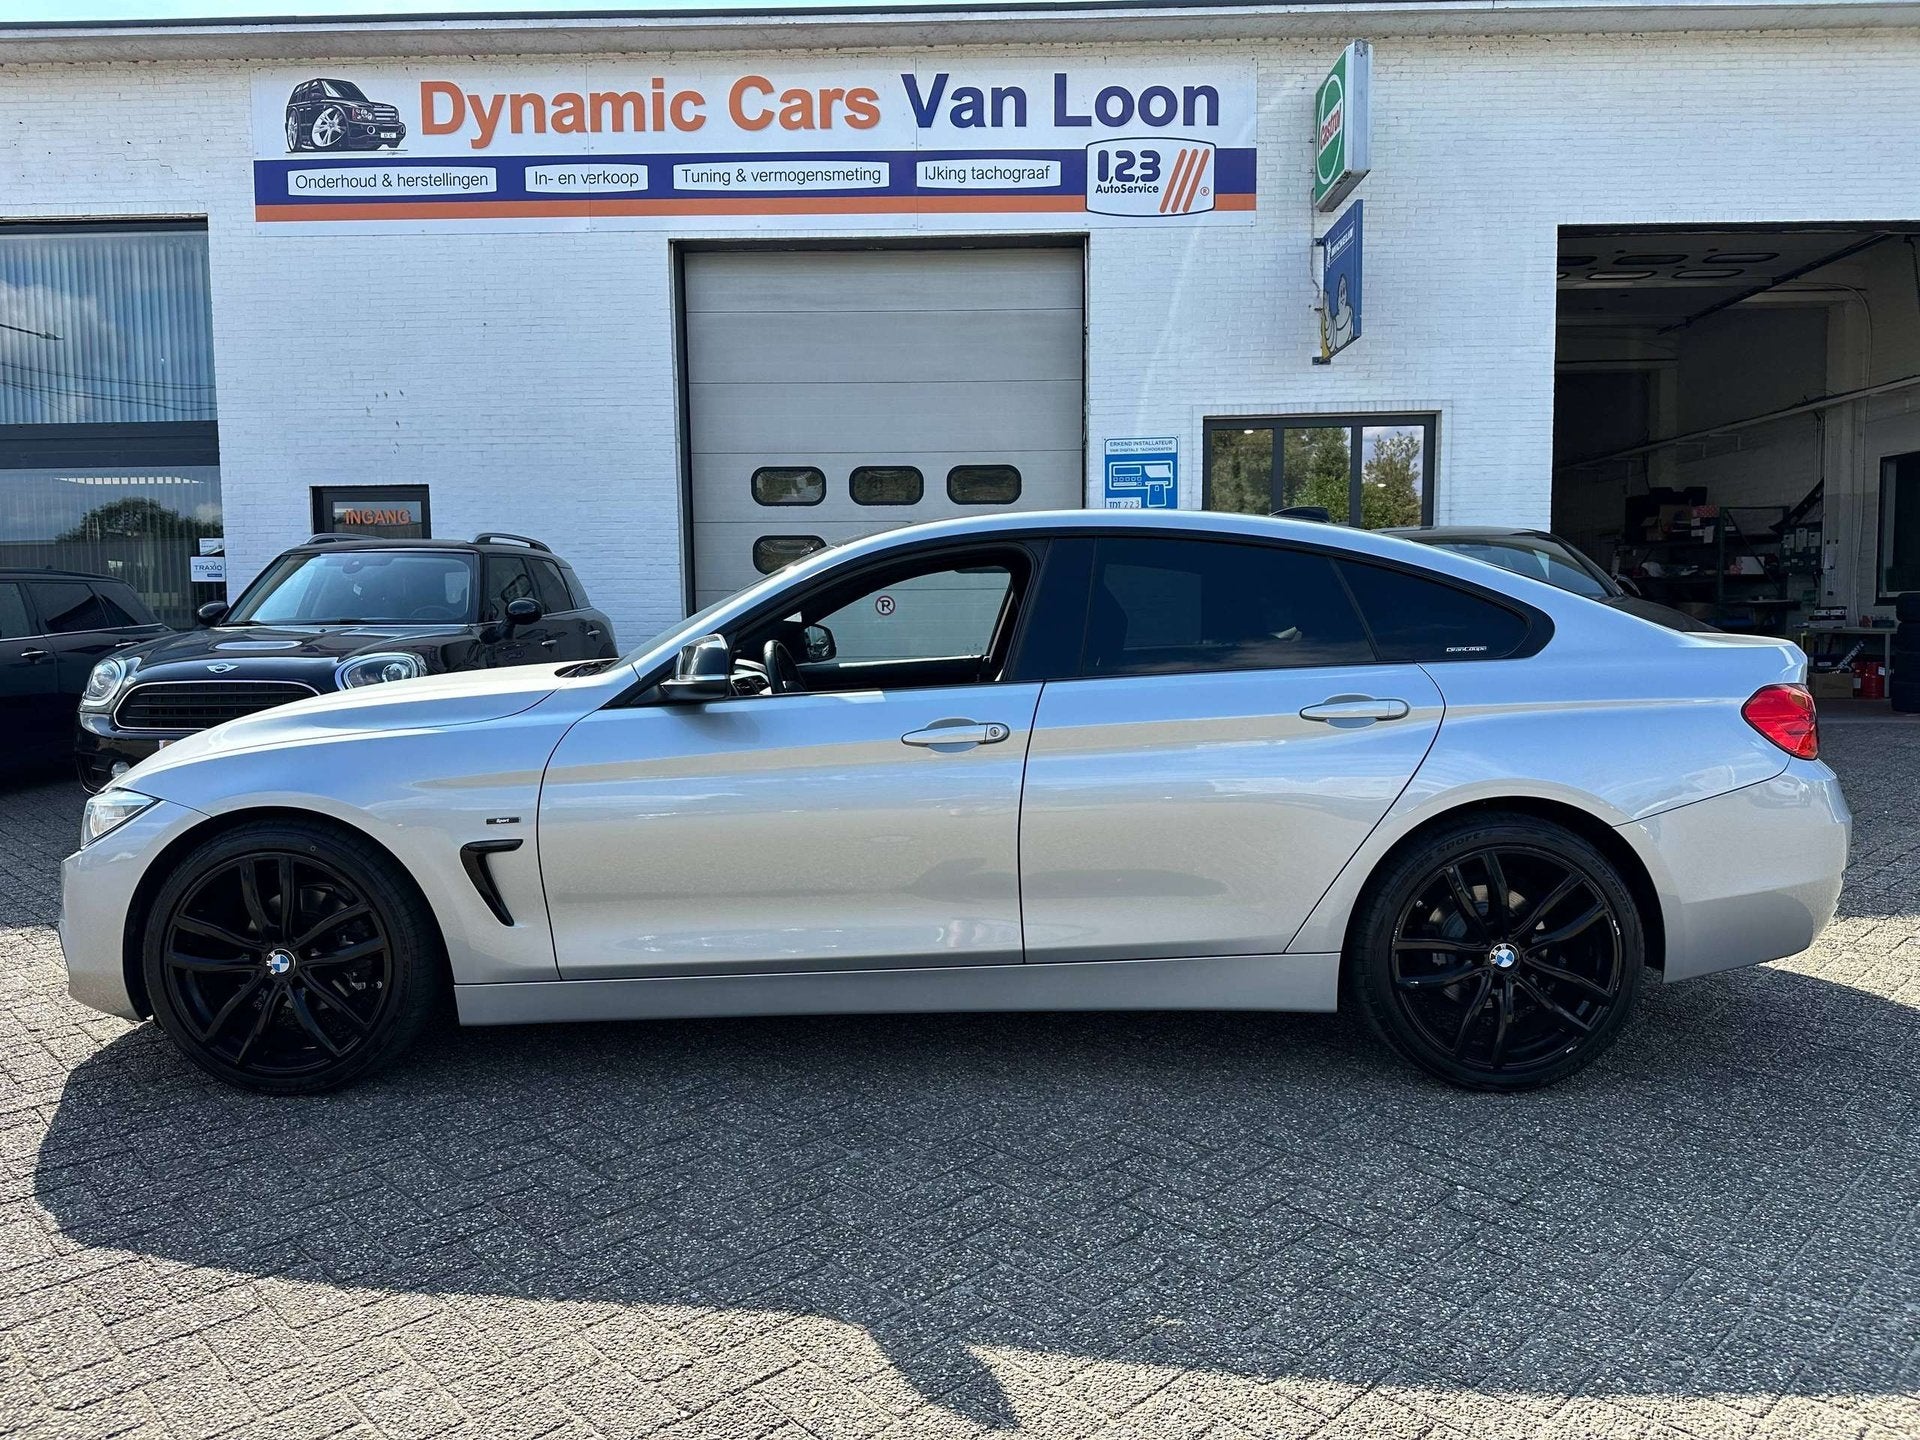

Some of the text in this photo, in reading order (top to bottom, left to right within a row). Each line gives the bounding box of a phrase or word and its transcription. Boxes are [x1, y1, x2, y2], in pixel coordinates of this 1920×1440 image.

[419, 72, 1219, 150] Dynamic Cars Van Loon
[295, 172, 489, 192] Onderhoud & herstellingen
[534, 171, 639, 190] In- en verkoop
[681, 166, 881, 185] Tuning & vermogensmeting
[925, 164, 1050, 183] IJking tachograaf
[1095, 183, 1160, 194] AutoService
[345, 509, 411, 525] INGANG
